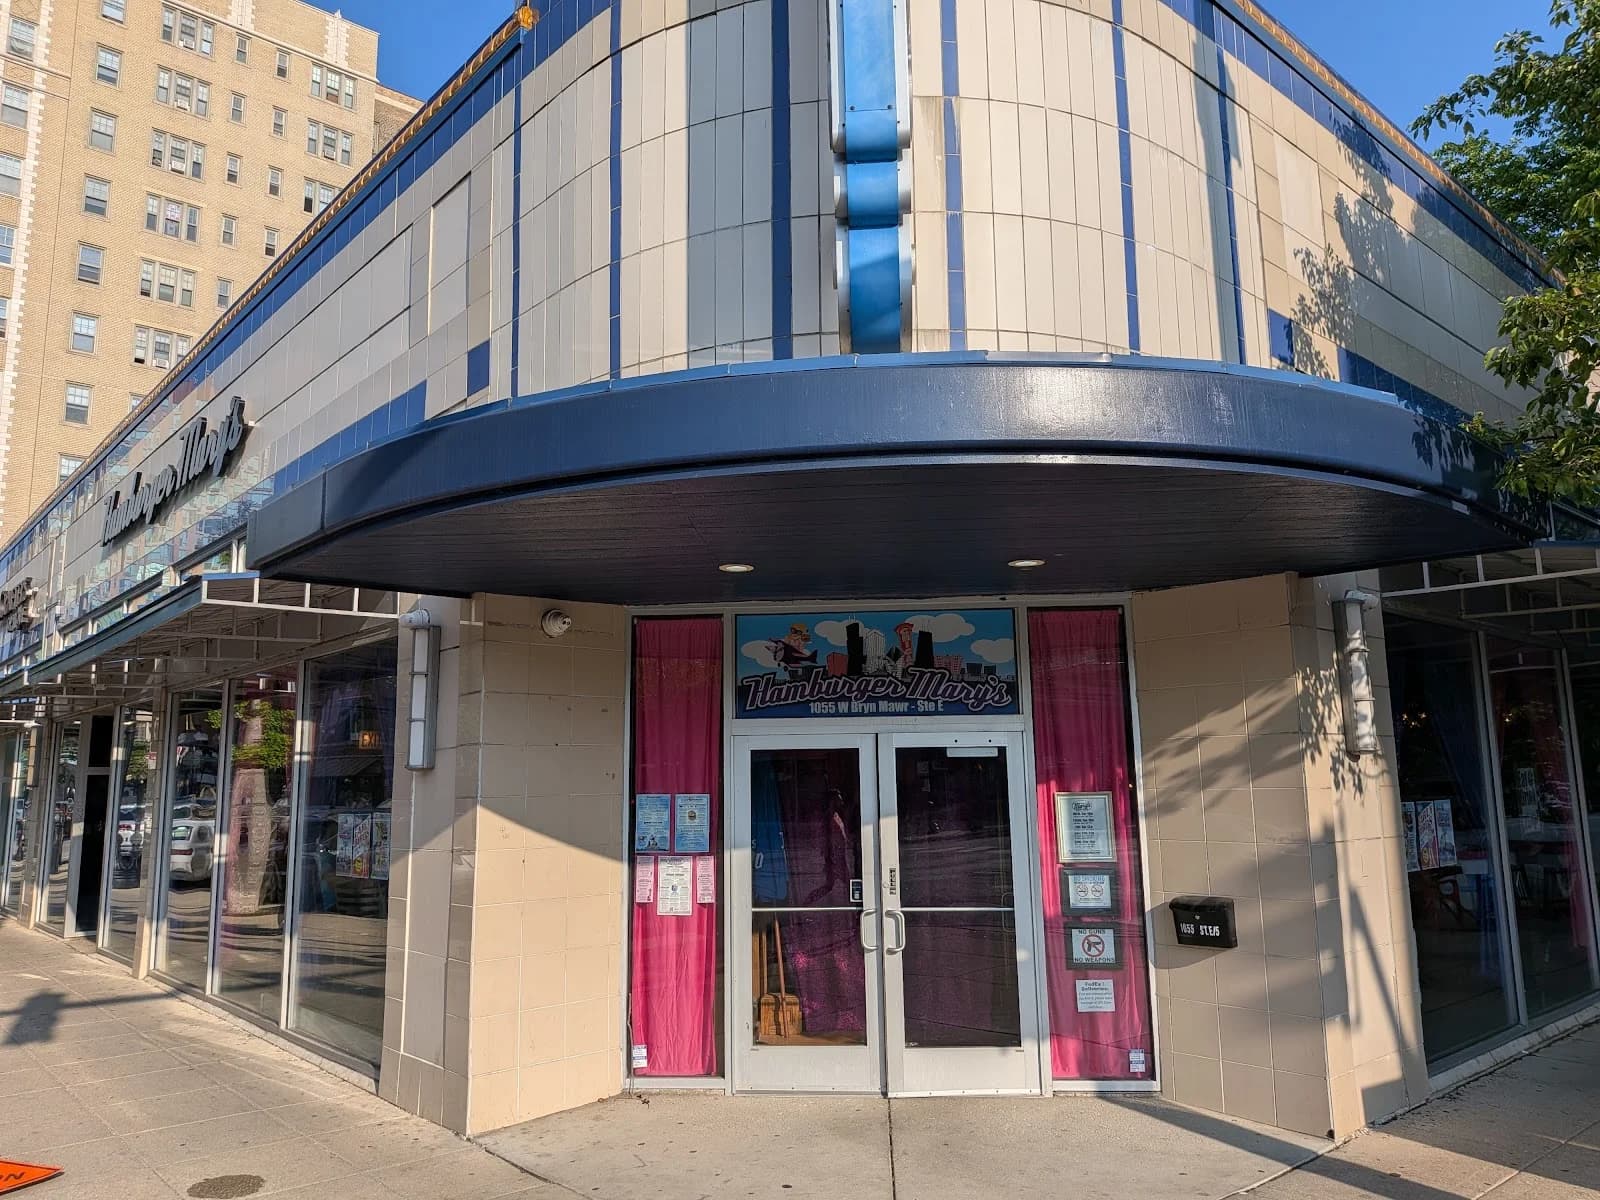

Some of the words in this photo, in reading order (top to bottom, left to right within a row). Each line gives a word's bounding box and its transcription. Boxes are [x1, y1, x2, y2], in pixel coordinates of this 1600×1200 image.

[743, 668, 905, 710] Hamburger
[906, 667, 1012, 711] Mary's
[809, 701, 836, 714] 1055
[837, 701, 849, 714] W
[851, 700, 877, 714] Bryn
[879, 700, 909, 712] Mawr
[917, 699, 936, 712] Ste
[937, 700, 944, 712] E
